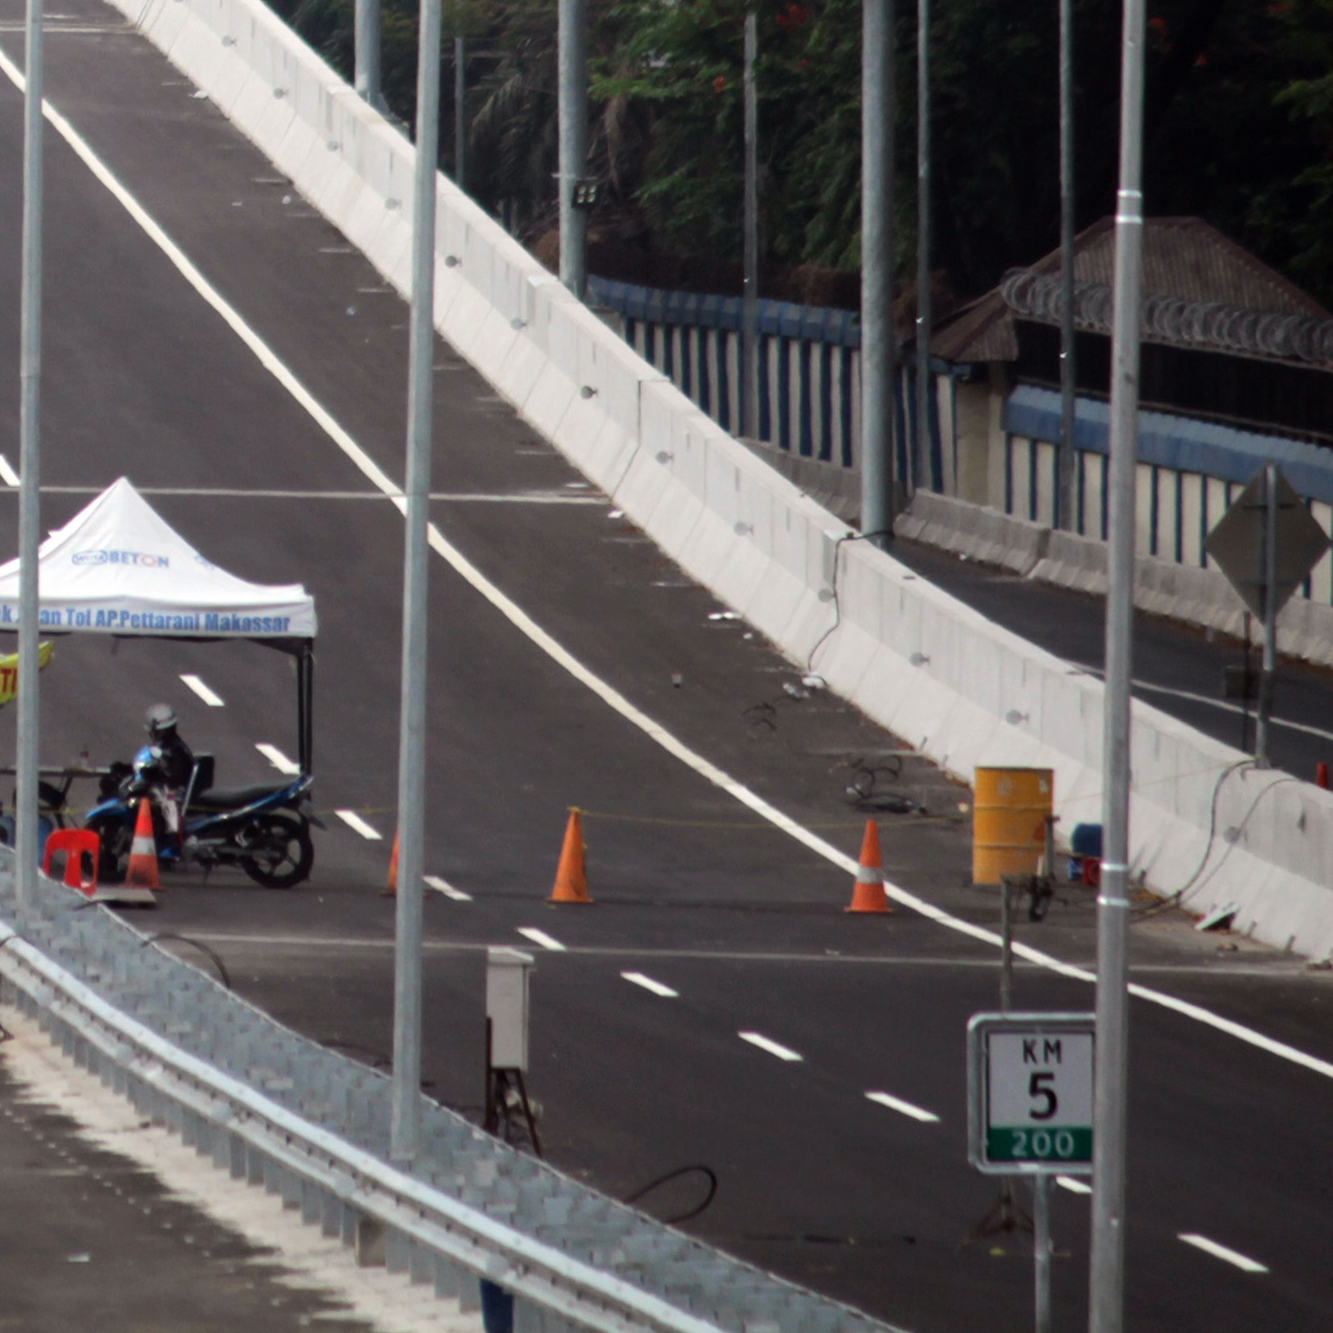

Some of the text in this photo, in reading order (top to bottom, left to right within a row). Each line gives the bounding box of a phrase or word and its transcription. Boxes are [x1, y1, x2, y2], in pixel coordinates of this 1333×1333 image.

[109, 551, 170, 568] BETON
[66, 608, 90, 626] Tol
[95, 609, 201, 630] AP.Pettarani
[205, 614, 291, 633] Makassar
[1023, 1039, 1062, 1063] KM
[1029, 1072, 1058, 1120] 5
[1011, 1130, 1075, 1158] 200
